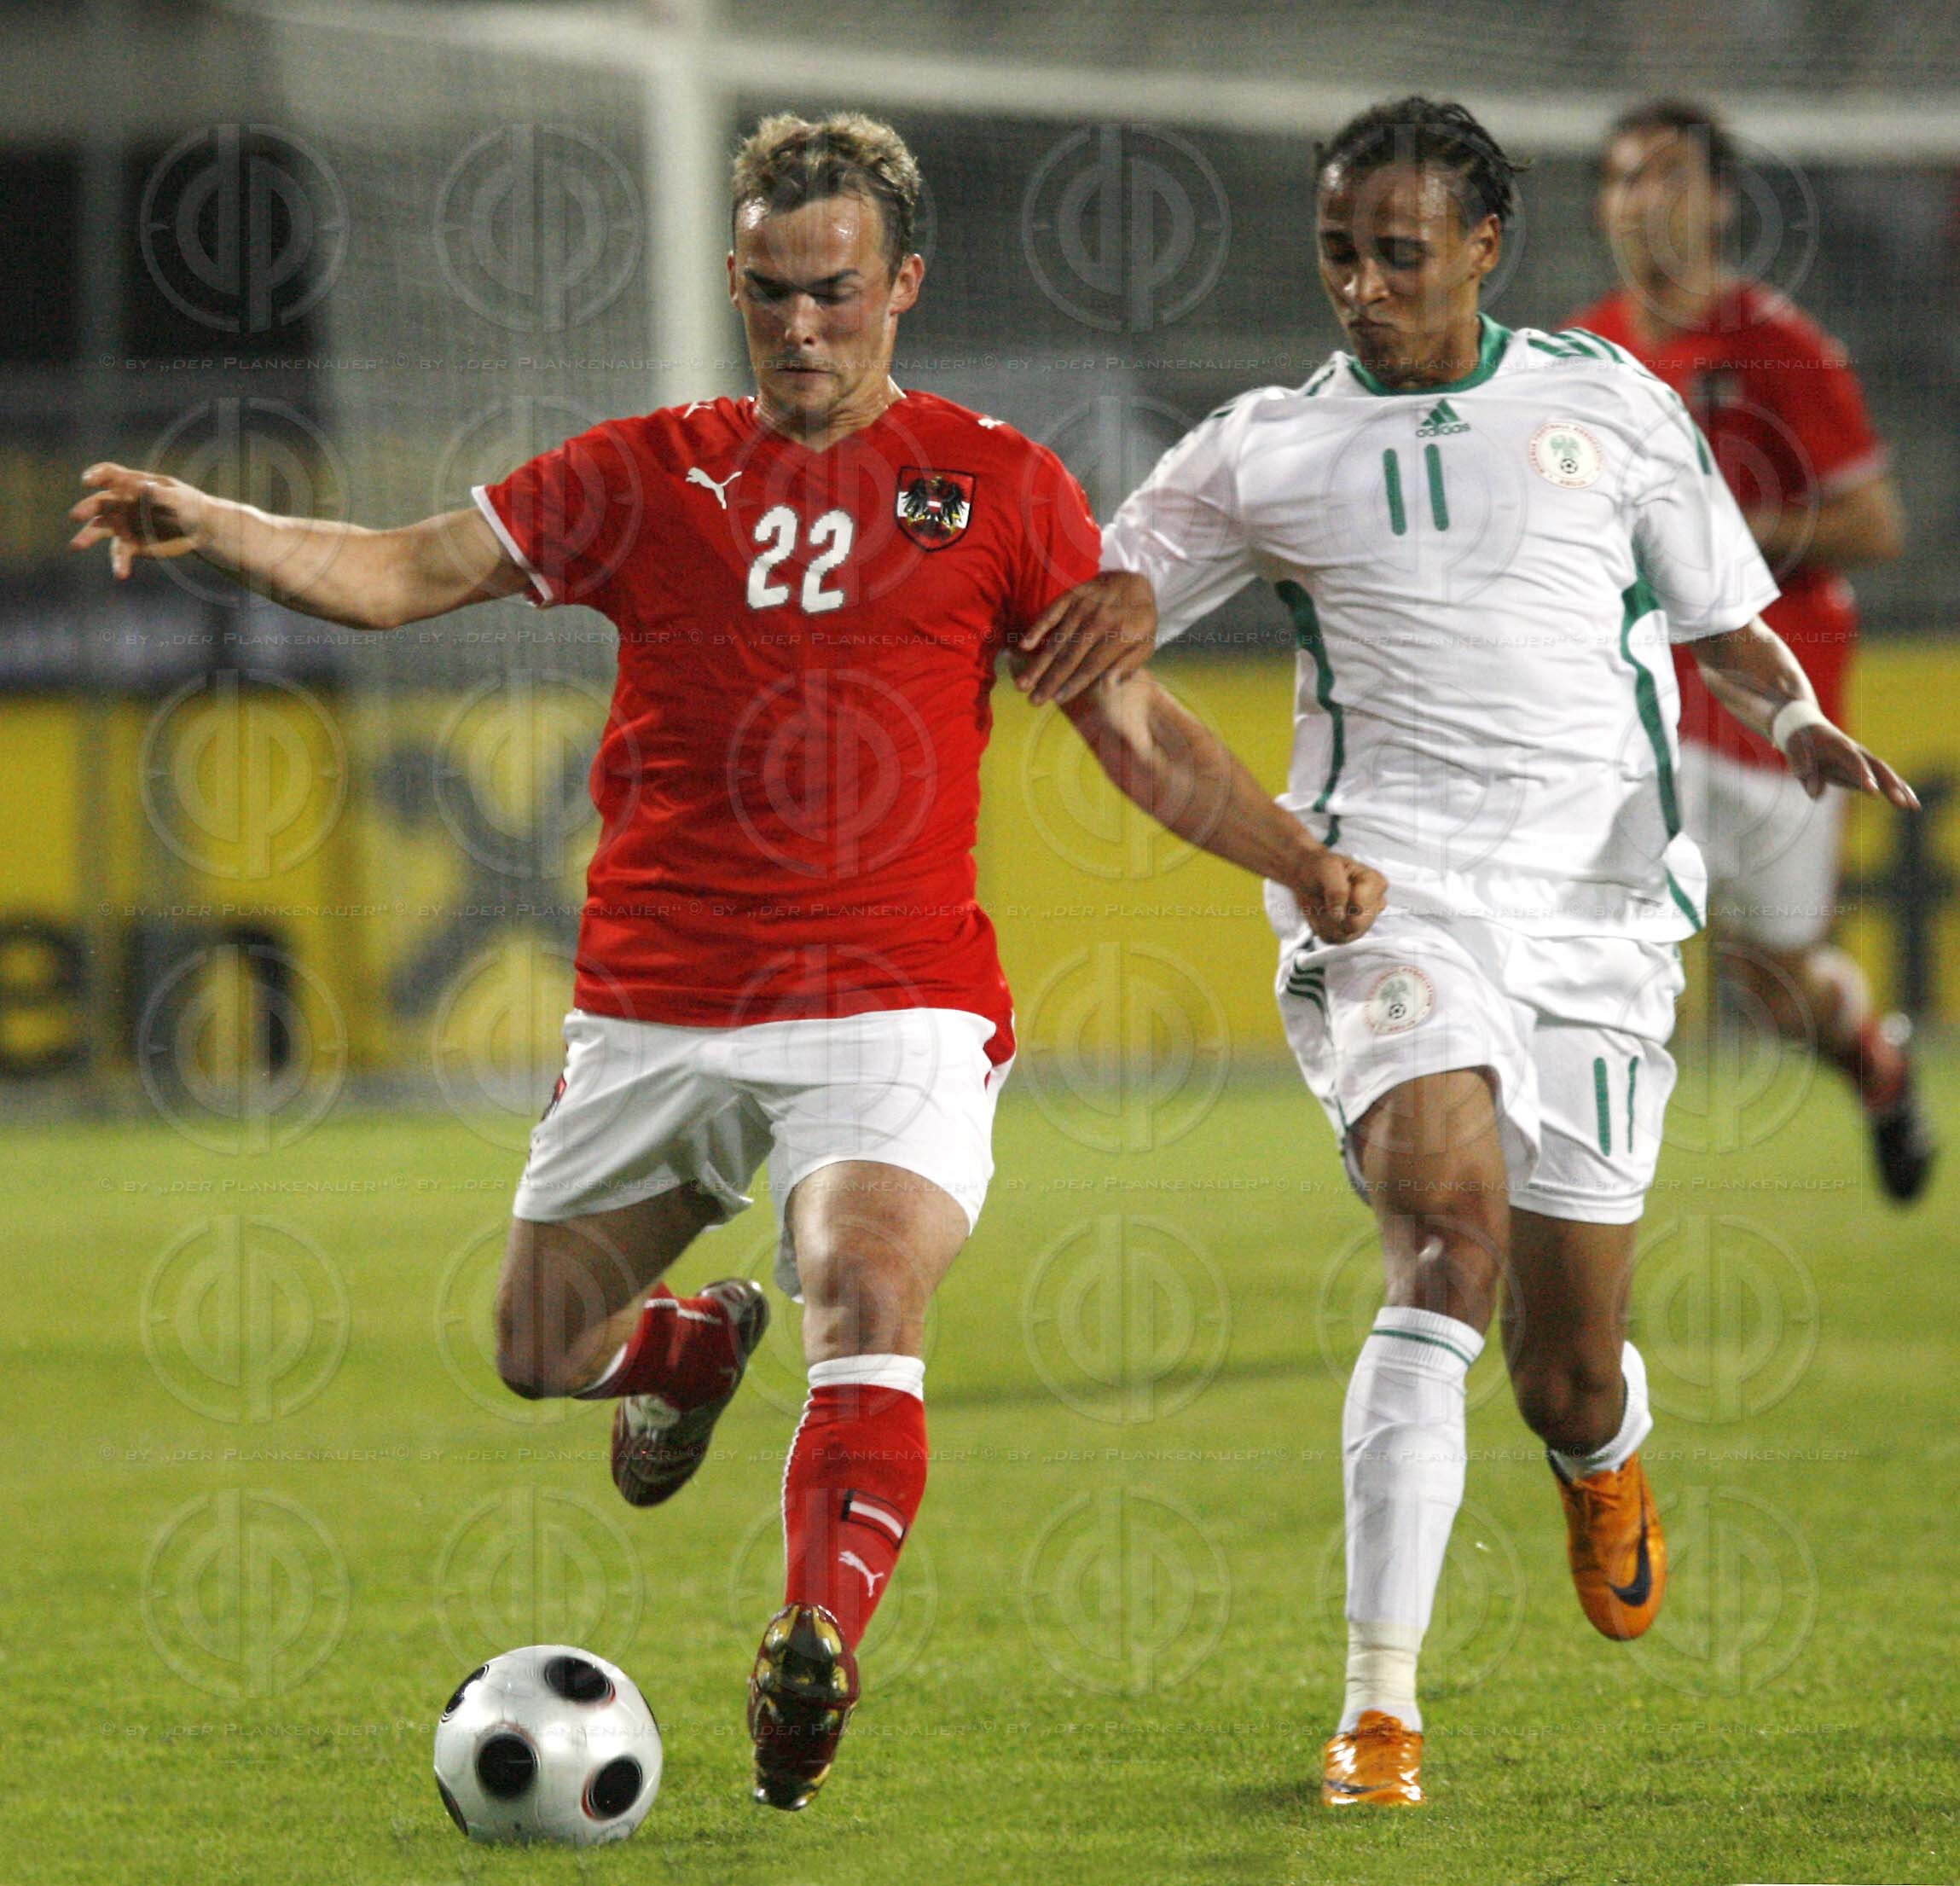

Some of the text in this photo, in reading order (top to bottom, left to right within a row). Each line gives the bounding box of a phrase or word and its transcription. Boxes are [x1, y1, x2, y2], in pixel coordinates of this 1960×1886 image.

[1416, 423, 1470, 438] adidas
[1382, 444, 1450, 537] 11
[747, 504, 855, 613] 22
[1593, 1055, 1639, 1157] 11
